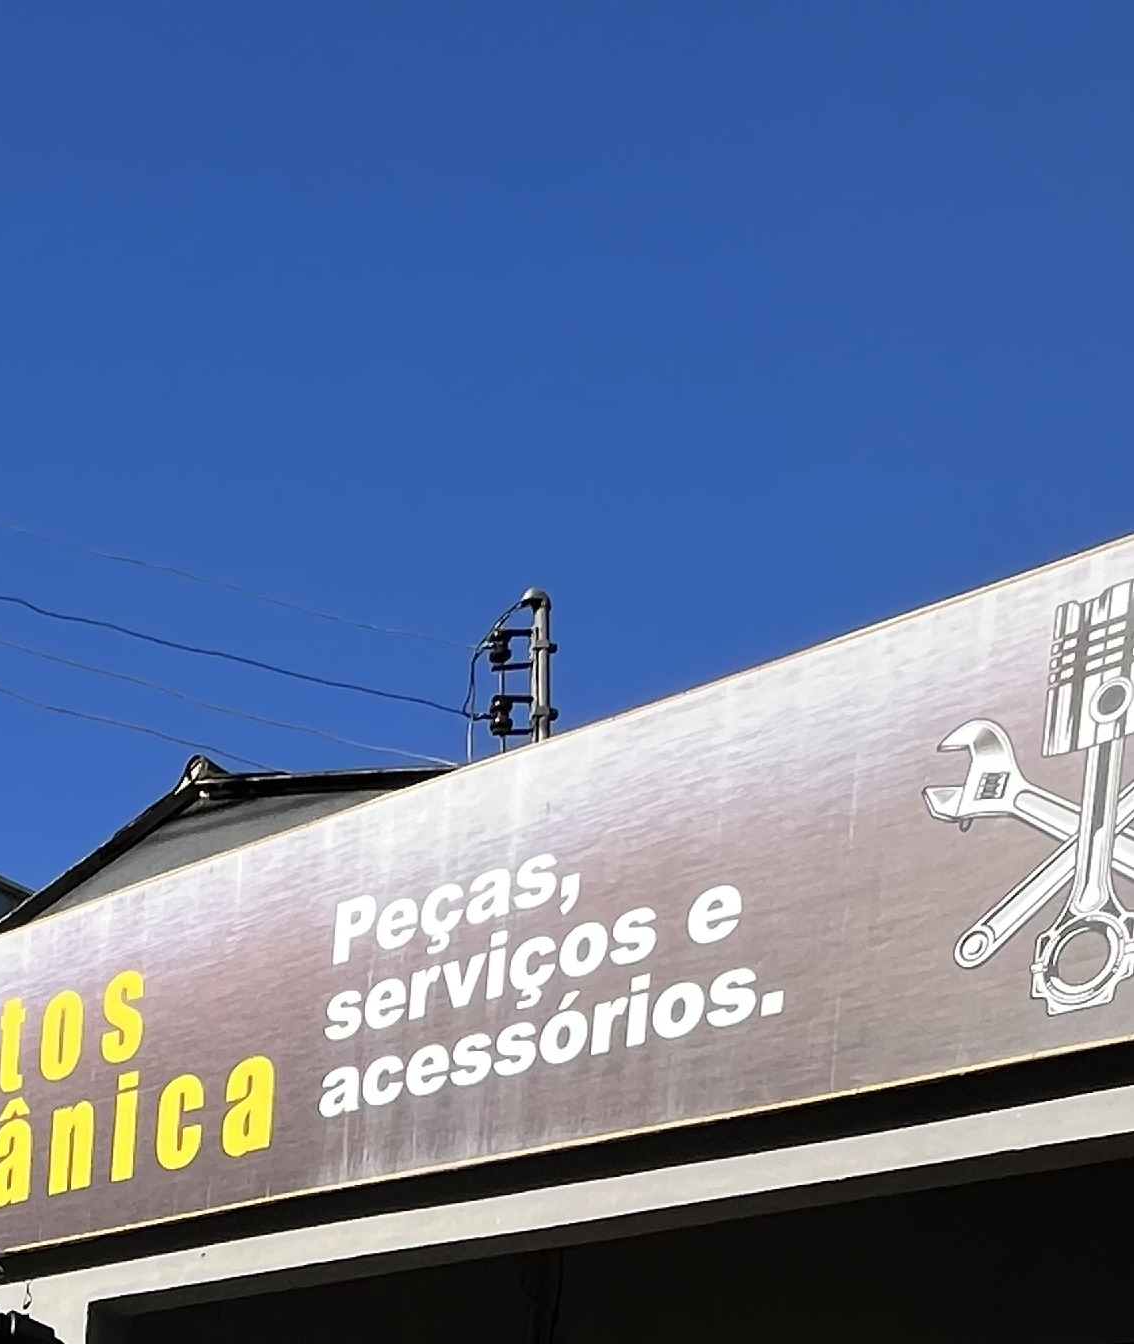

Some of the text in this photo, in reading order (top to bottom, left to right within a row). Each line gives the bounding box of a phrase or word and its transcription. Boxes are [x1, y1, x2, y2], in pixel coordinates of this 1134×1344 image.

[324, 884, 743, 1041] serviços e
[332, 852, 582, 966] Peças,
[318, 966, 785, 1119] acessórios.
